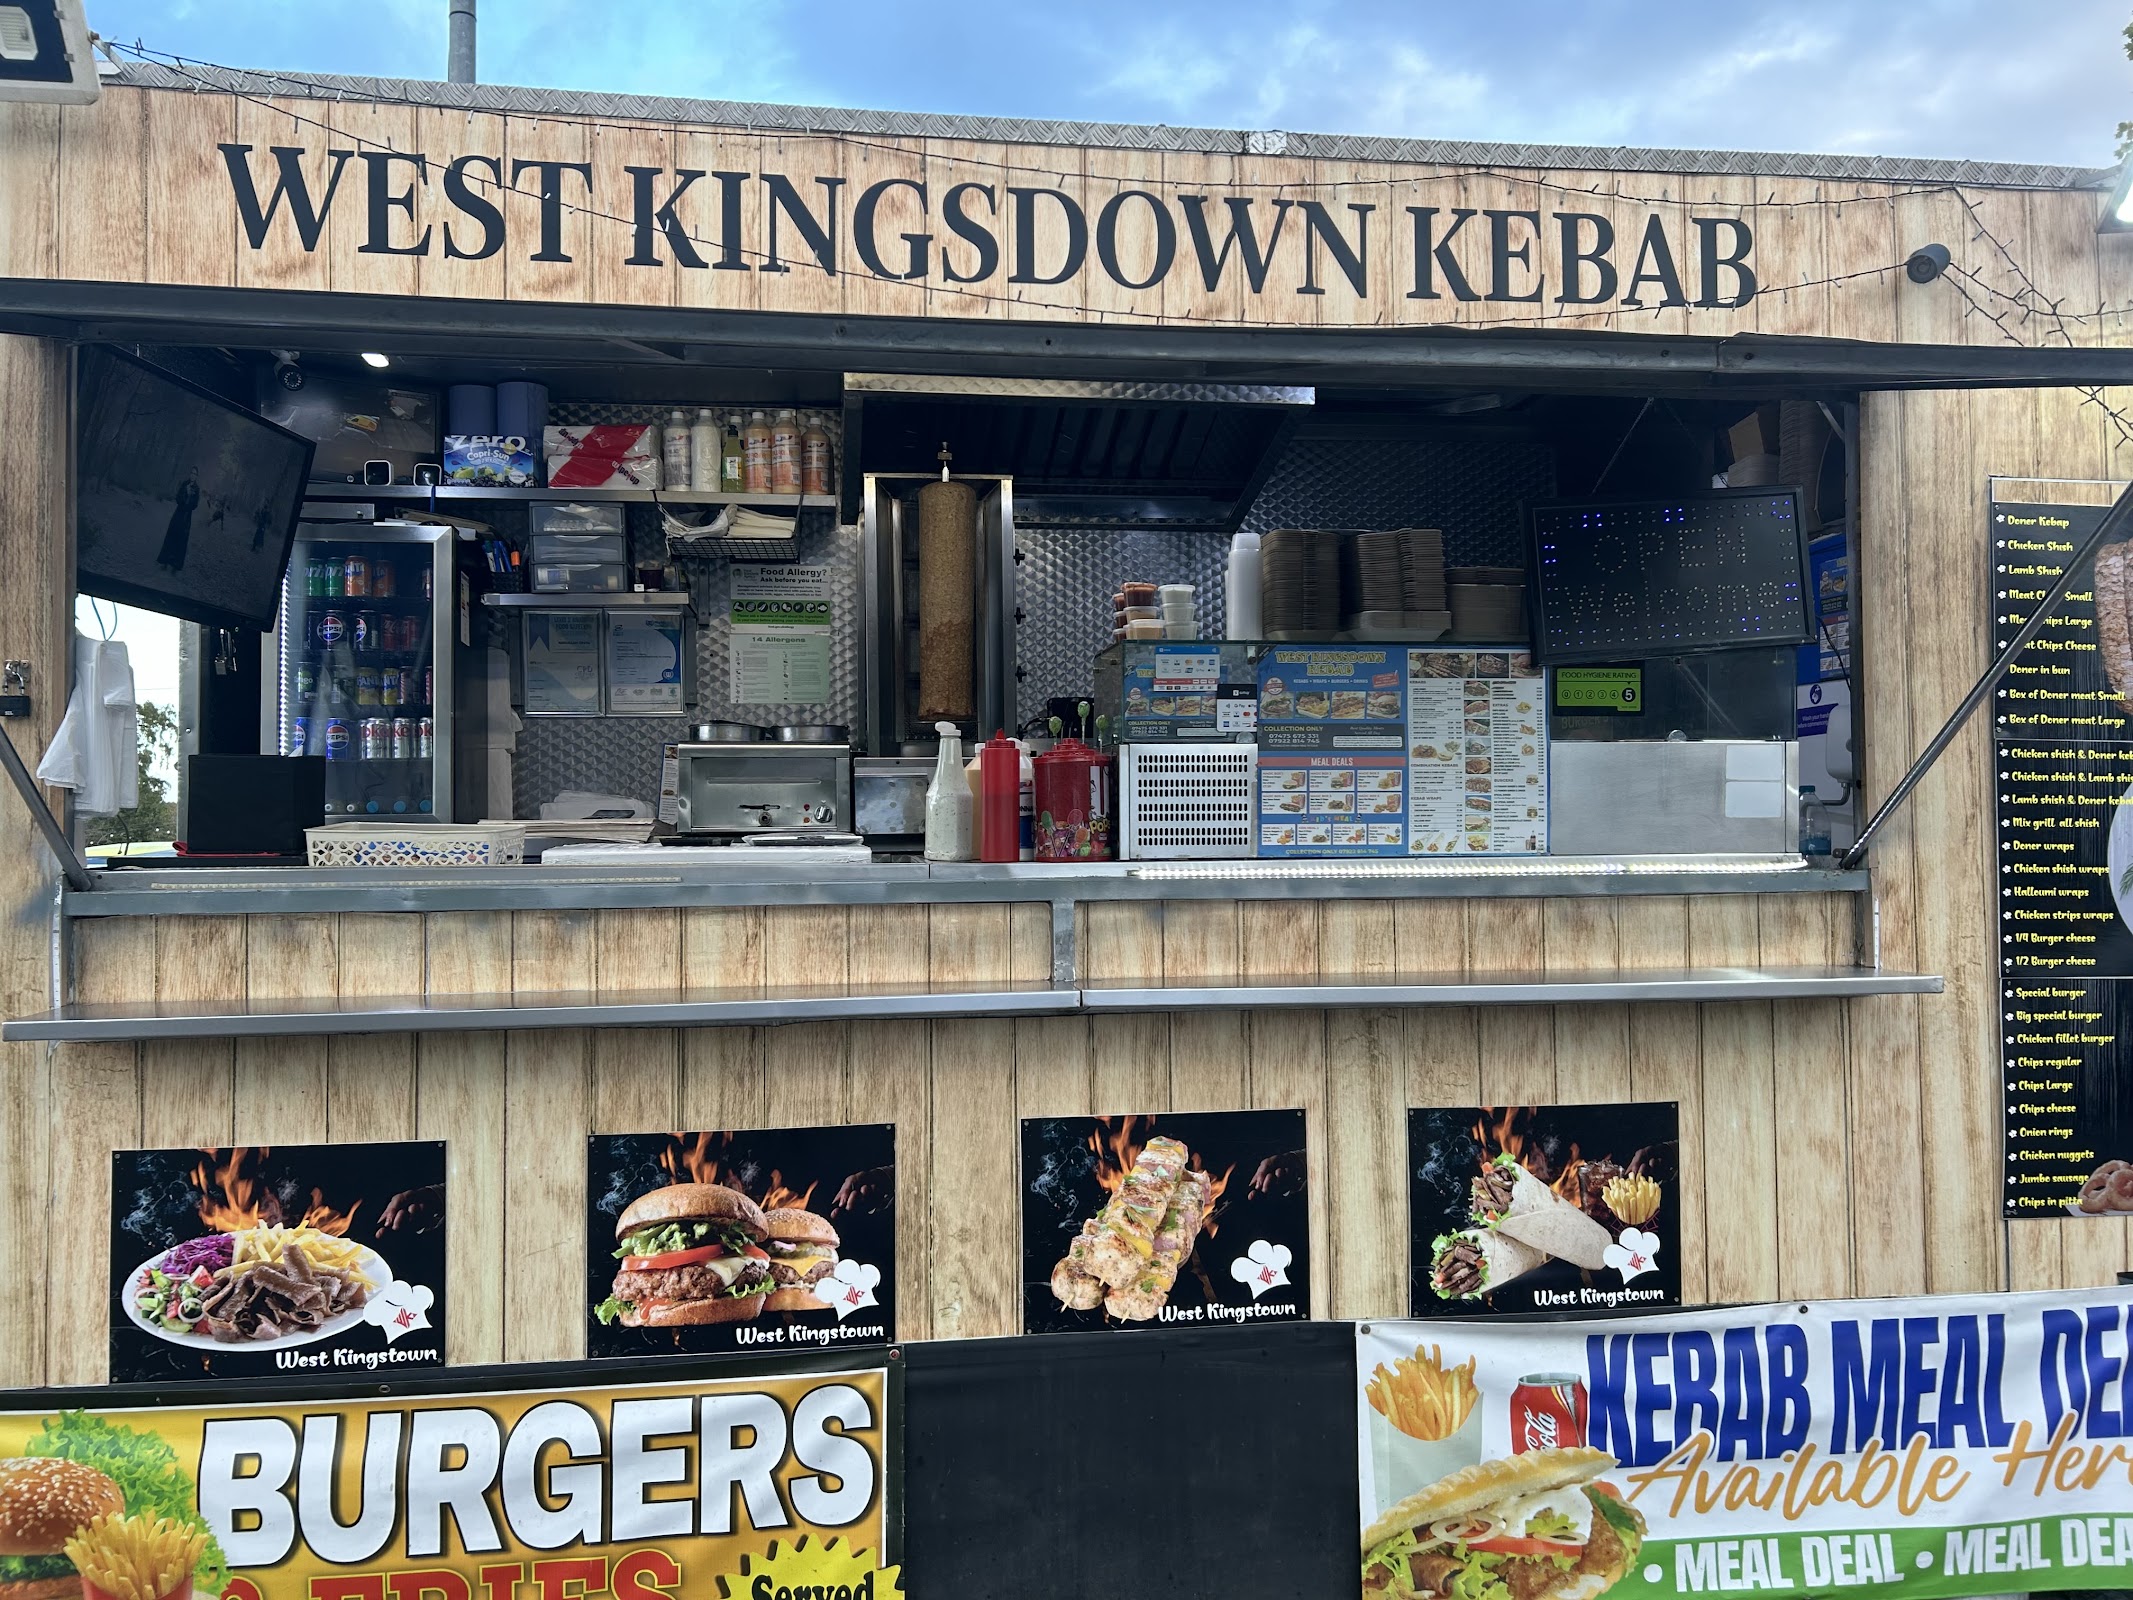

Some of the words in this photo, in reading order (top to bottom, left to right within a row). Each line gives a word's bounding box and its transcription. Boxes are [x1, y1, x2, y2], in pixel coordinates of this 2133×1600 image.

[218, 142, 593, 263] WEST
[624, 166, 1376, 299] KINGSDOWN
[1406, 206, 1757, 309] KEBAB
[2007, 515, 2036, 525] Doner
[2038, 516, 2069, 528] Kebap
[1593, 526, 1746, 574] OPEN
[2007, 540, 2045, 550] Chicken
[2047, 541, 2072, 551] Shish
[787, 568, 827, 577] Allergy?
[2008, 566, 2035, 575] Lamb
[2036, 565, 2062, 575] Shish
[1564, 580, 1780, 623] Welcome
[2008, 589, 2035, 599] Meat
[2064, 591, 2093, 601] Small
[2064, 615, 2092, 629] Large
[2036, 639, 2063, 652] Chips
[2064, 640, 2097, 651] Cheese
[1275, 651, 1309, 663] WEST
[1311, 652, 1386, 664] KINGSDOWN
[1307, 664, 1354, 676] KEBAB
[2009, 664, 2038, 674] Doner
[2040, 666, 2050, 674] in
[2051, 666, 2070, 675] bun
[1624, 689, 1633, 701] 5
[2009, 688, 2026, 699] Box
[2028, 690, 2039, 699] of
[2039, 689, 2068, 699] Doner
[2070, 692, 2095, 700] meat
[2097, 691, 2126, 702] Small
[2009, 714, 2027, 724] Box
[2027, 715, 2039, 724] of
[2040, 714, 2069, 724] Doner
[2070, 717, 2097, 725] meat
[2097, 717, 2126, 728] Large
[2011, 748, 2049, 759] Chicken
[2050, 750, 2076, 759] shish
[2077, 749, 2085, 759] &
[2087, 749, 2115, 760] Doner
[1311, 757, 1330, 766] MEAL
[1331, 757, 1353, 766] DEALS
[2011, 771, 2049, 781] Chicken
[2050, 772, 2076, 781] shish
[2077, 772, 2086, 782] &
[2088, 773, 2115, 783] Lamb
[2012, 795, 2039, 804] Lamb
[2039, 795, 2065, 804] shish
[2066, 795, 2075, 805] &
[2077, 795, 2106, 805] Doner
[2012, 817, 2031, 827] Mix
[2033, 817, 2055, 830] grill
[2059, 817, 2073, 827] all
[2074, 819, 2098, 828] shish
[2012, 839, 2041, 850] Doner
[2043, 843, 2075, 852] wraps
[2013, 863, 2050, 873] Chicken
[2051, 864, 2077, 874] shish
[2078, 866, 2110, 875] wraps
[2013, 886, 2057, 897] Halloumi
[2057, 889, 2089, 898] wraps
[2014, 909, 2051, 920] Chicken
[2052, 911, 2082, 921] strips
[2082, 912, 2114, 921] wraps
[2015, 932, 2029, 942] 1/4
[2030, 932, 2064, 944] Burger
[2065, 933, 2096, 943] cheese
[2015, 955, 2029, 965] 1/2
[2030, 955, 2064, 967] Burger
[2065, 956, 2096, 965] cheese
[2015, 987, 2050, 999] Special
[2051, 987, 2085, 1000] burger
[2016, 1010, 2032, 1023] Big
[2033, 1010, 2067, 1022] special
[2068, 1010, 2102, 1023] burger
[2017, 1033, 2054, 1043] Chicken
[2055, 1032, 2080, 1043] fillet
[2080, 1033, 2114, 1046] burger
[2017, 1056, 2044, 1068] Chips
[2045, 1057, 2081, 1069] regular
[2018, 1080, 2045, 1092] Chips
[2045, 1080, 2074, 1092] Large
[2019, 1103, 2045, 1115] Chips
[2046, 1103, 2076, 1113] cheese
[2019, 1127, 2047, 1137] Onion
[2048, 1127, 2073, 1139] rings
[2019, 1150, 2056, 1160] Chicken
[2056, 1150, 2094, 1162] nuggets
[2019, 1173, 2051, 1183] Jumbo
[2051, 1175, 2090, 1185] sausage
[2018, 1196, 2046, 1208] Chips
[2046, 1198, 2057, 1206] in
[2058, 1196, 2084, 1207] pitta
[1534, 1290, 1578, 1307] West
[1580, 1288, 1664, 1308] Kingstown
[1158, 1304, 1203, 1324] West
[1206, 1301, 1296, 1325] Kingstown
[736, 1325, 786, 1345] West
[789, 1323, 884, 1346] Kingstown
[276, 1350, 331, 1369] West
[334, 1347, 438, 1370] Kingstown
[1586, 1324, 1811, 1468] KEBAB
[1830, 1314, 2015, 1455] MEAL
[200, 1384, 875, 1567] BURGERS
[1626, 1432, 1971, 1520] Available
[1675, 1539, 1794, 1592] MEAL
[1801, 1534, 1904, 1587] DEAL
[1944, 1523, 2051, 1577] MEAL
